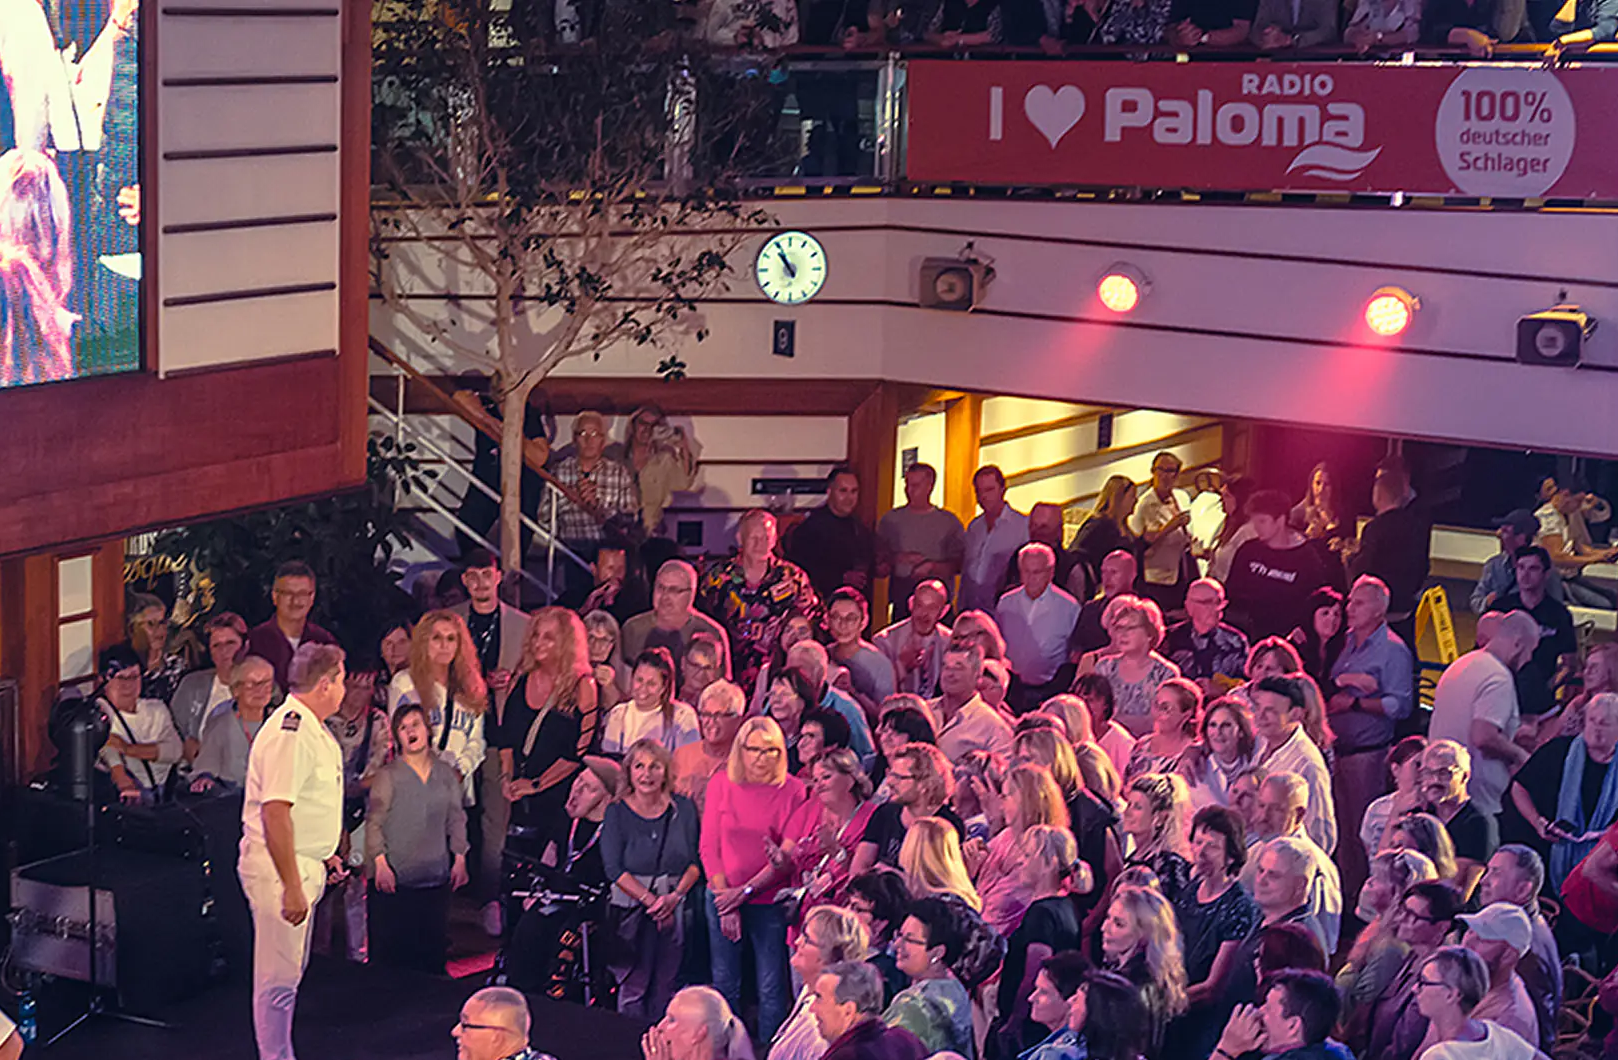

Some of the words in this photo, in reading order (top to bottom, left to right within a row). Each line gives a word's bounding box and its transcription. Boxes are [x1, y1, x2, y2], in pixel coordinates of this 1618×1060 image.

[1242, 73, 1334, 96] RADIO
[989, 86, 1004, 140] I
[1104, 87, 1365, 148] Paloma
[1460, 90, 1552, 123] 100%
[1459, 128, 1551, 147] deutscher
[1458, 151, 1551, 178] Schlager
